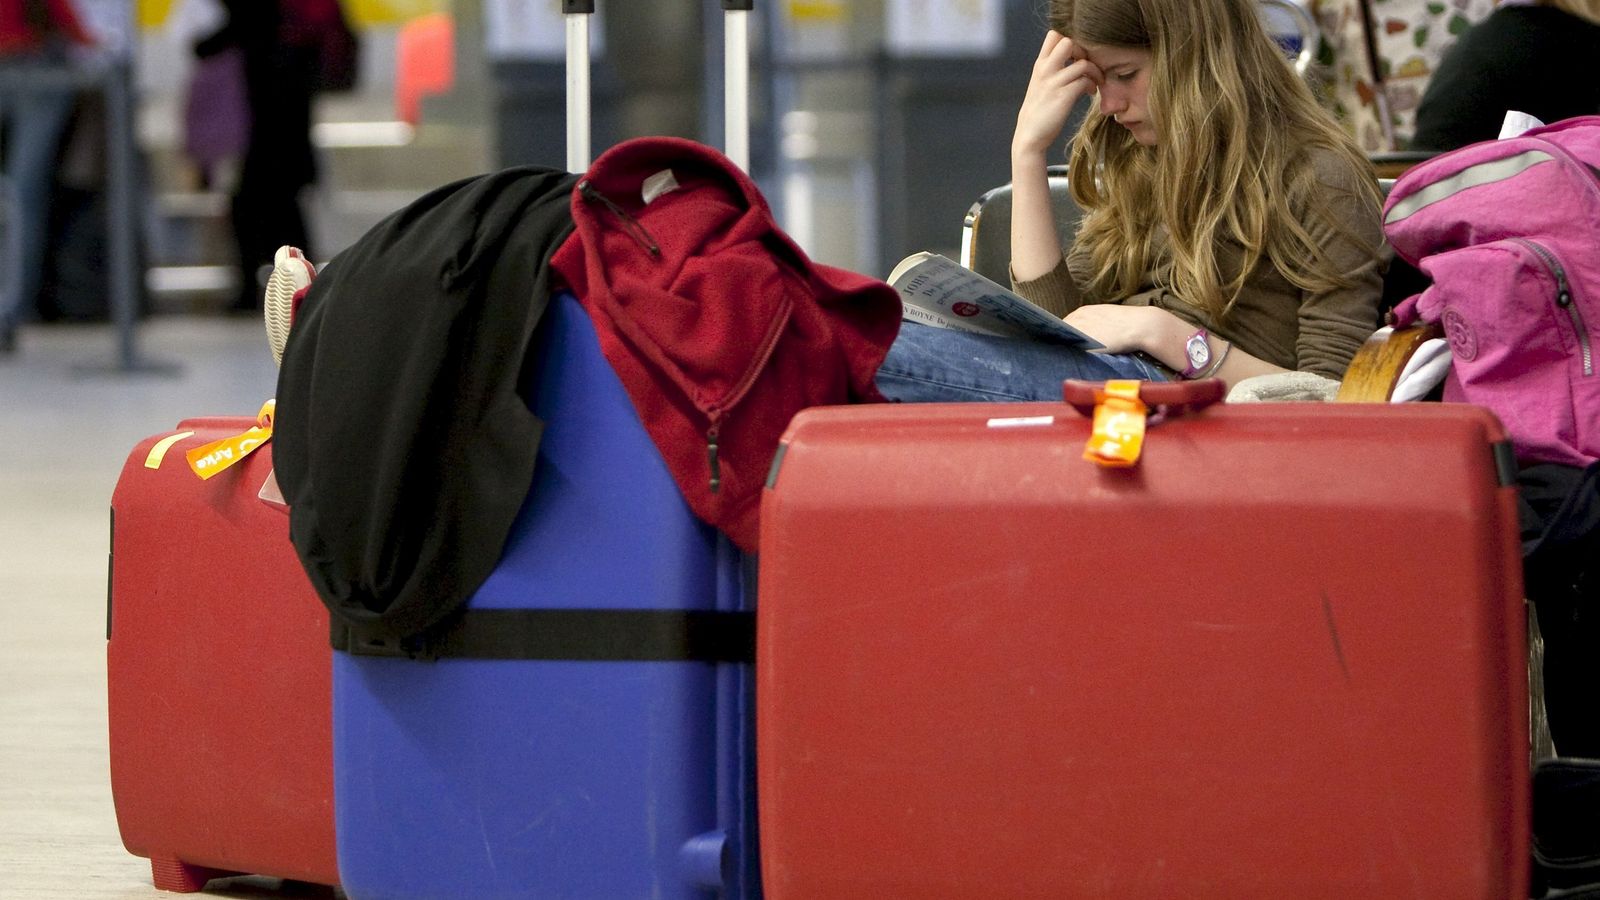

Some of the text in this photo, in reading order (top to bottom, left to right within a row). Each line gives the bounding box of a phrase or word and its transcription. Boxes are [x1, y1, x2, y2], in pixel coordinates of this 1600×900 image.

[903, 273, 929, 296] JOHN
[910, 308, 934, 321] BOYNE
[196, 447, 234, 468] Arke
